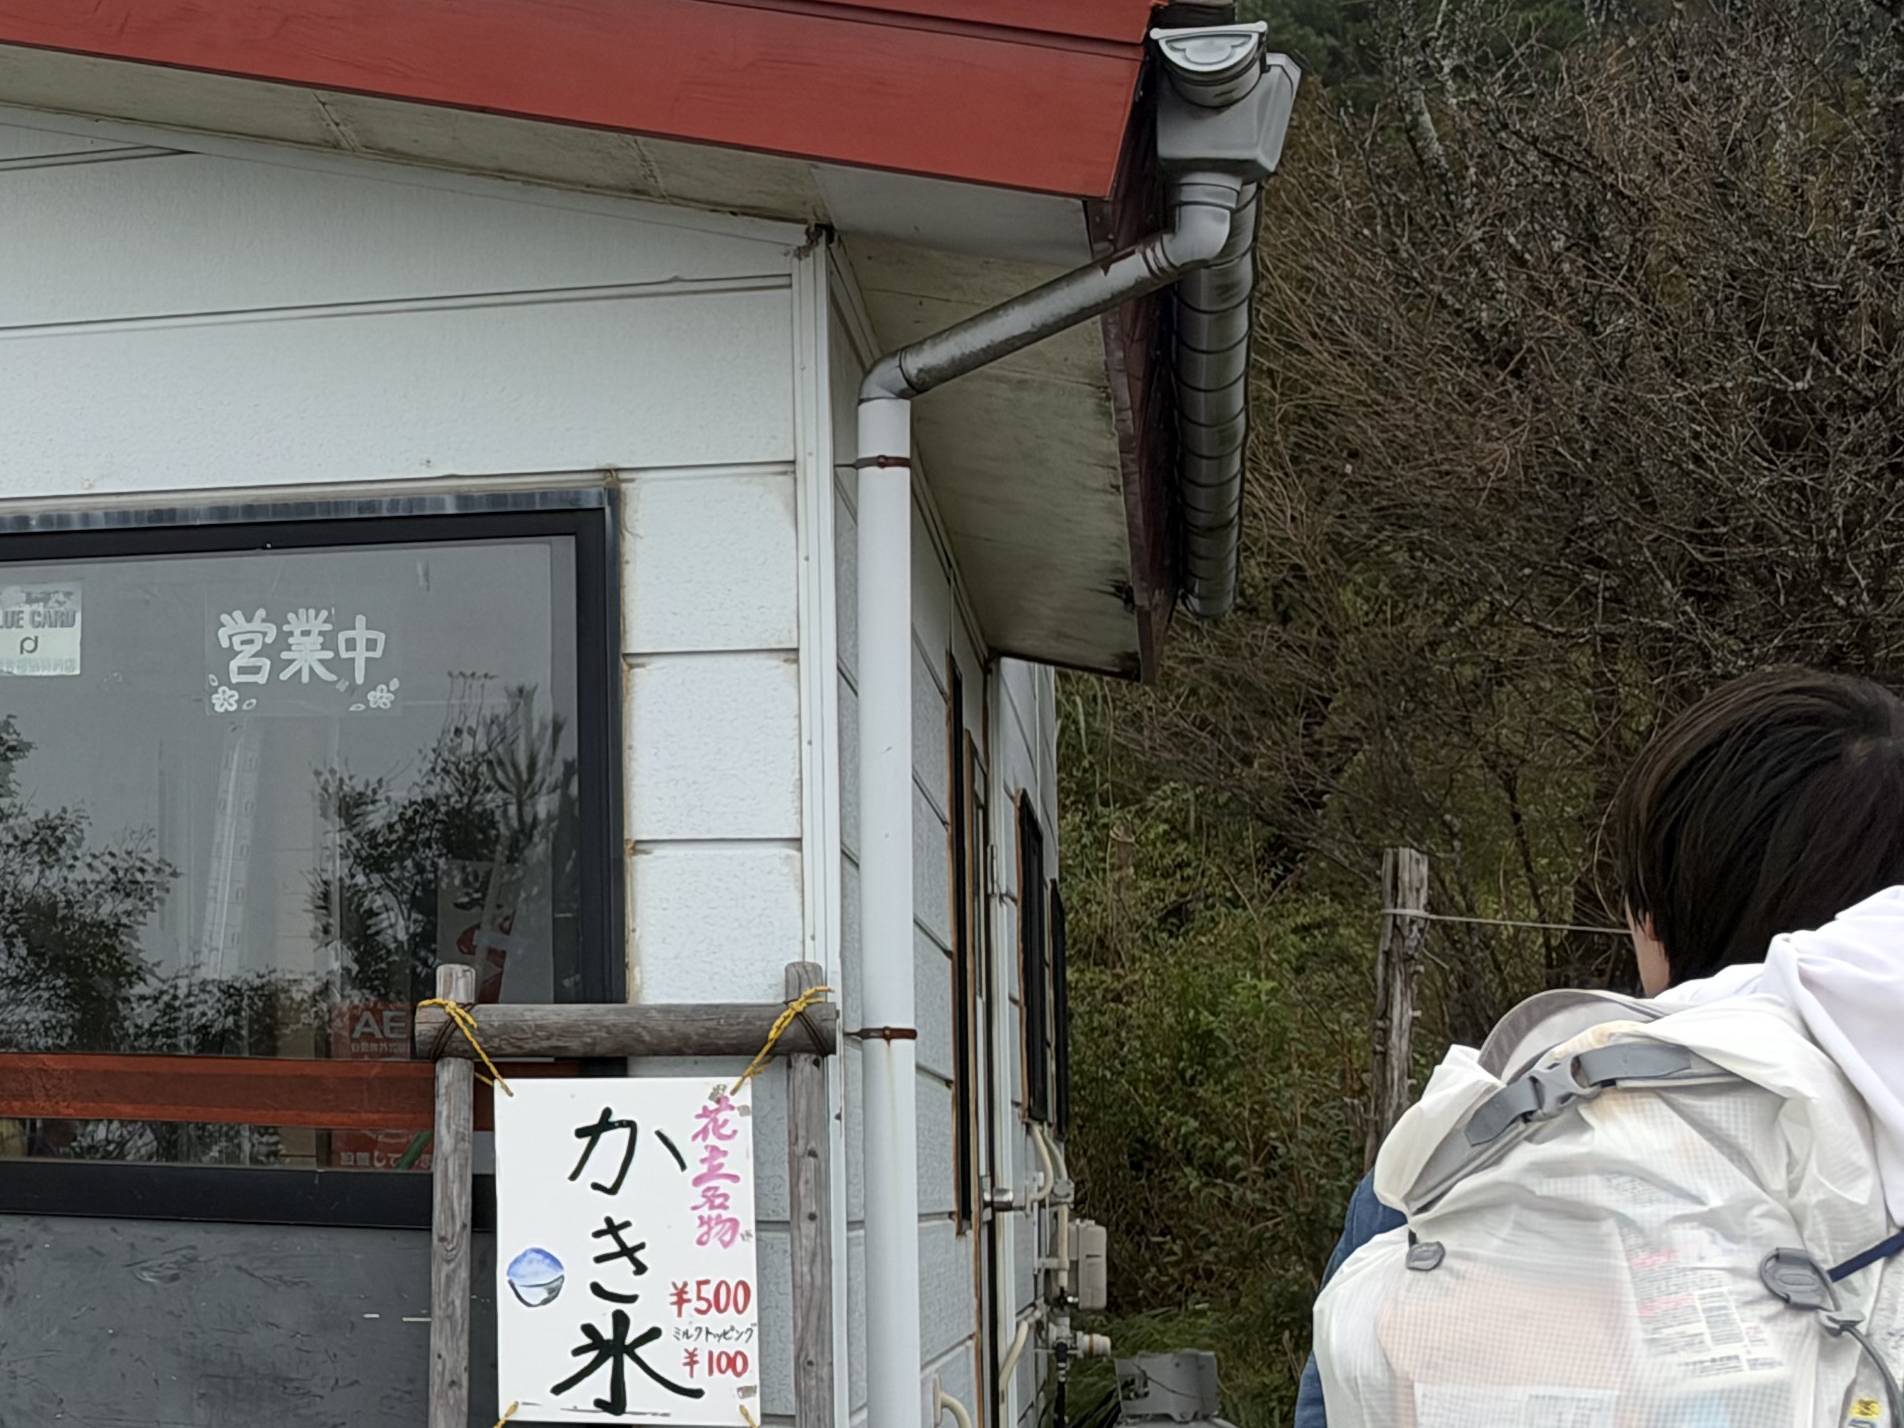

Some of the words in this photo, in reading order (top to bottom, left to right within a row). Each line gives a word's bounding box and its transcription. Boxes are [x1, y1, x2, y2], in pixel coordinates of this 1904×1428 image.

[29, 608, 76, 629] CARD
[217, 607, 386, 685] 営業中
[550, 1106, 705, 1416] かき氷
[669, 1278, 751, 1318] ¥500
[673, 1322, 758, 1344] ミルクトッピング
[682, 1347, 749, 1379] ¥100
